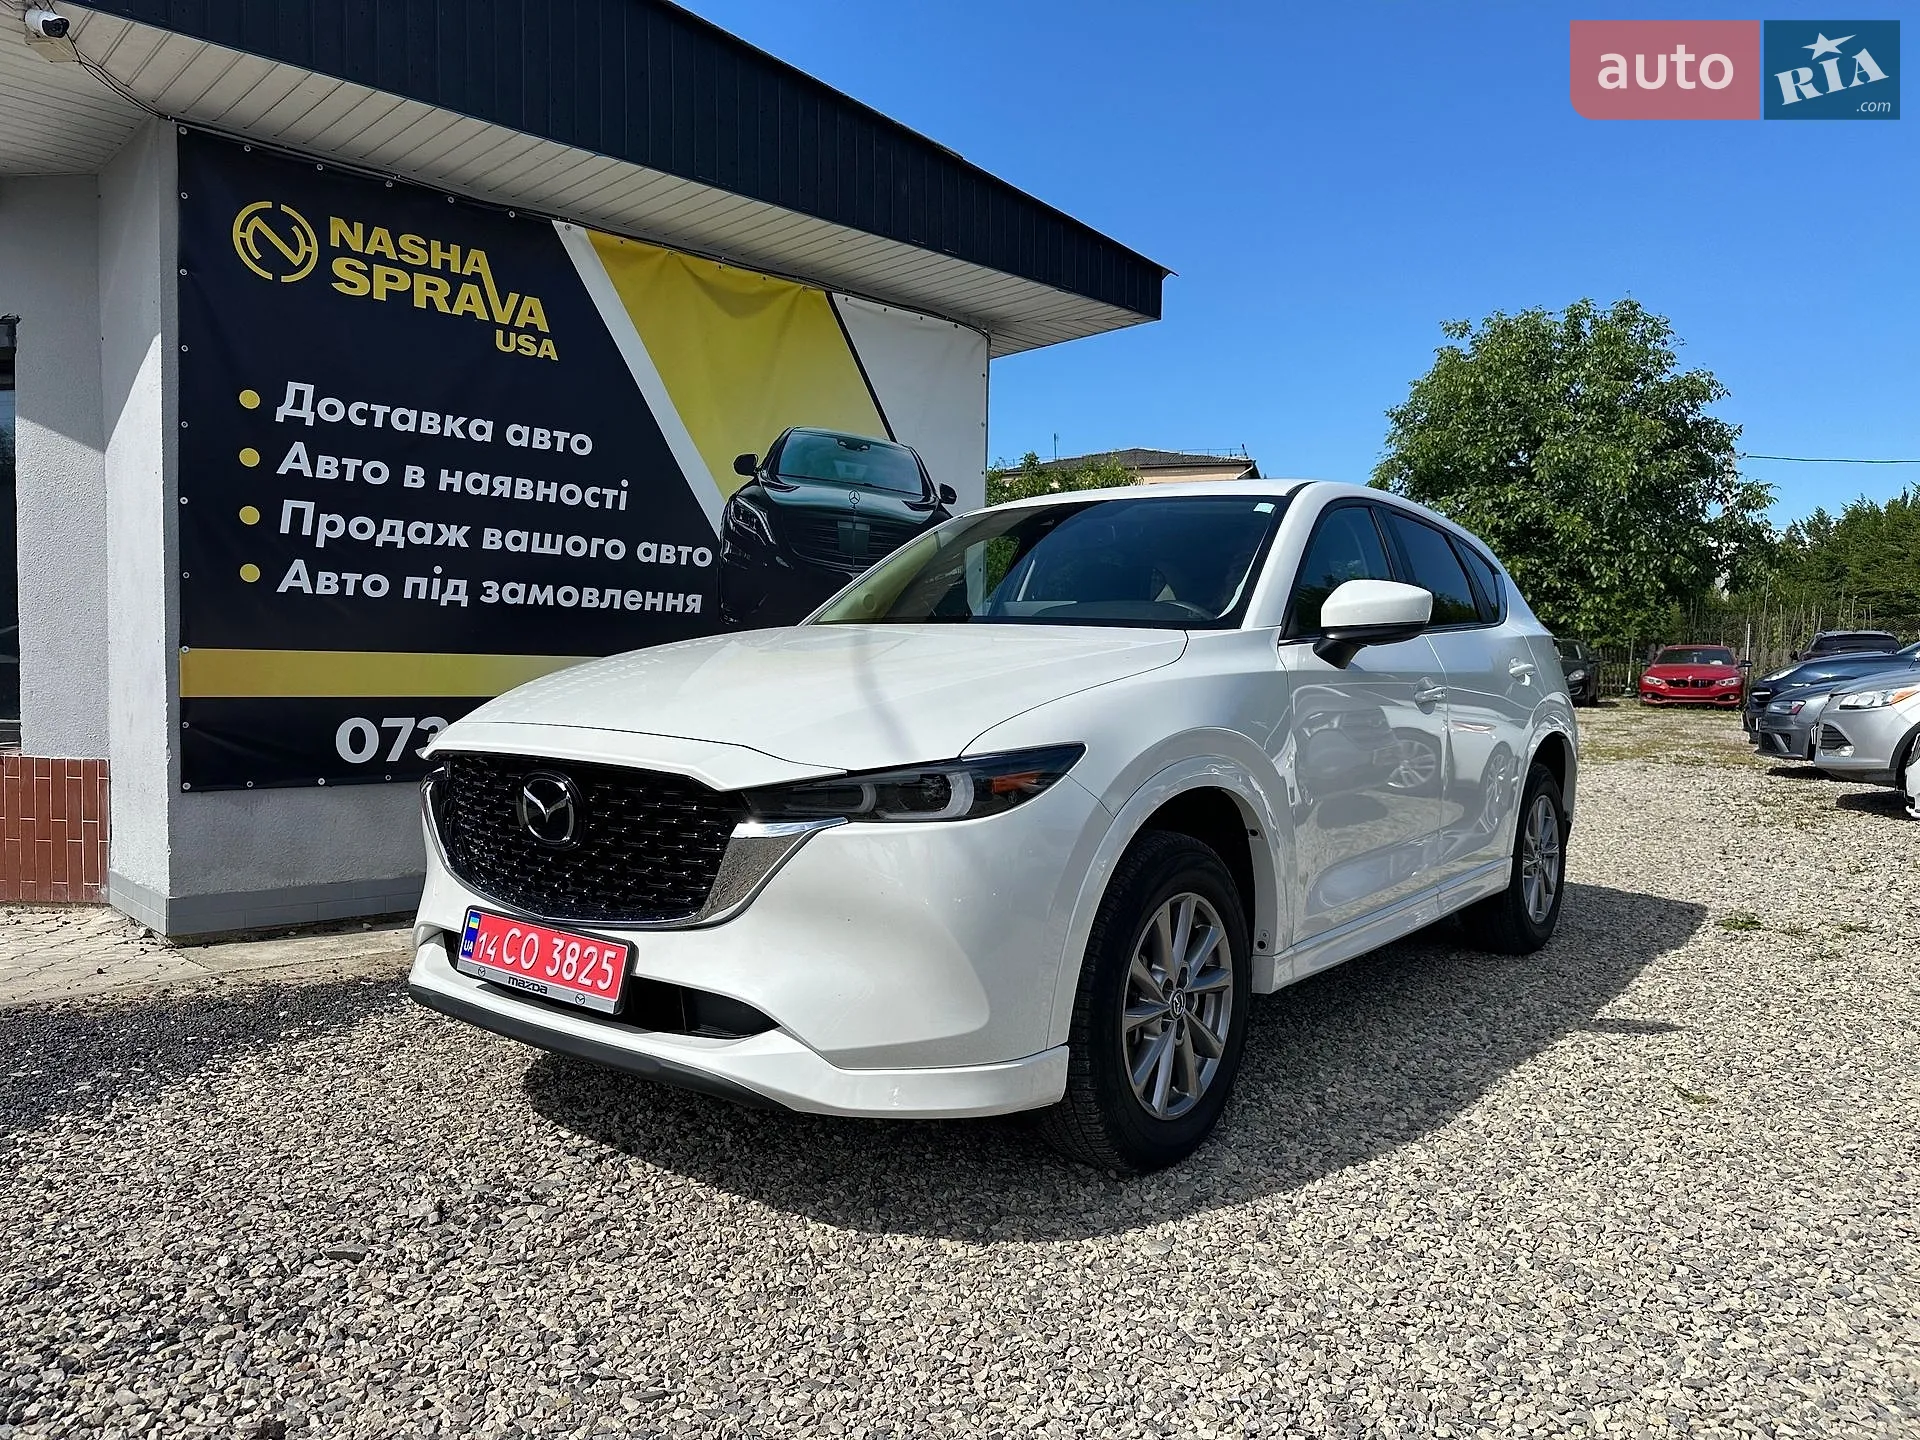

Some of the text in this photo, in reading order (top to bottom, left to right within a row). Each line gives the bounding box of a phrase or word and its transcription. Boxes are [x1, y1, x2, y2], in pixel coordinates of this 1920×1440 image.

[329, 216, 489, 276] NASHA
[331, 257, 550, 333] SPRAVA
[495, 329, 559, 361] USA
[274, 380, 593, 456] Доставка авто
[275, 441, 630, 512] Авто в наявності
[279, 499, 713, 568] Продаж вашого авто
[275, 558, 703, 614] Авто під замовлення
[545, 937, 618, 991] 3825
